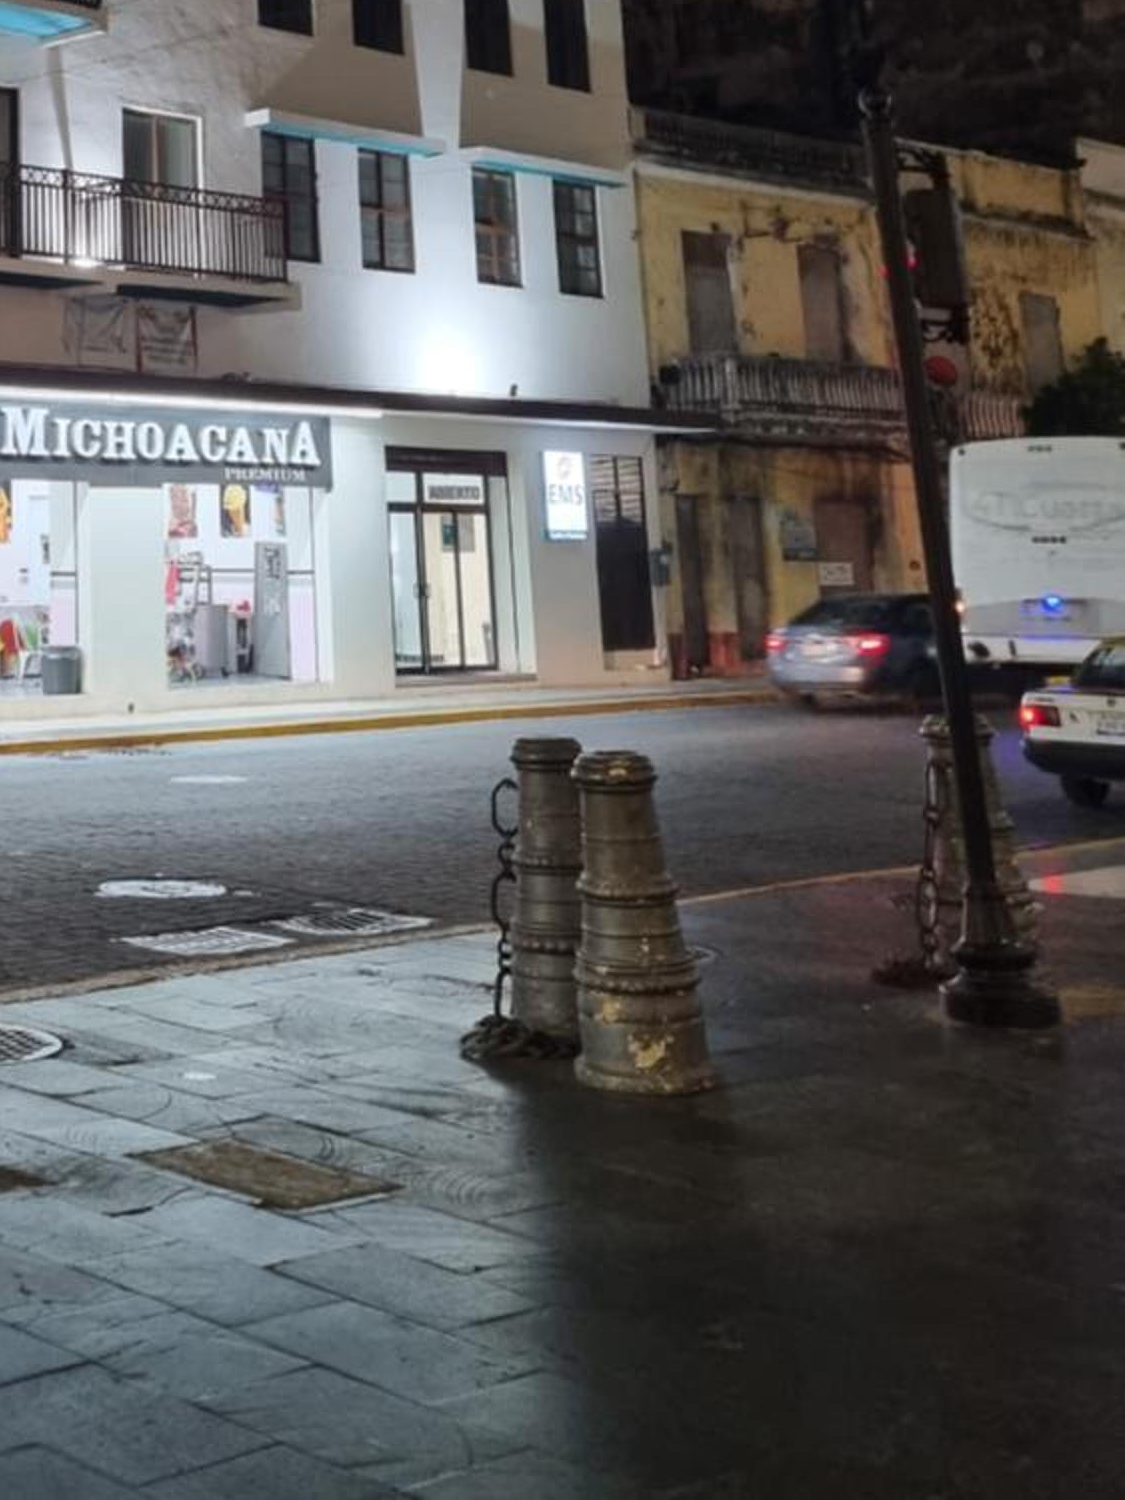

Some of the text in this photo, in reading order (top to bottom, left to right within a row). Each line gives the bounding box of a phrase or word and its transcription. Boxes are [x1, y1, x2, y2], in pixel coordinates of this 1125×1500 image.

[0, 406, 321, 467] MICHOACANA
[224, 468, 307, 482] PREMIUM
[549, 484, 584, 505] EMS
